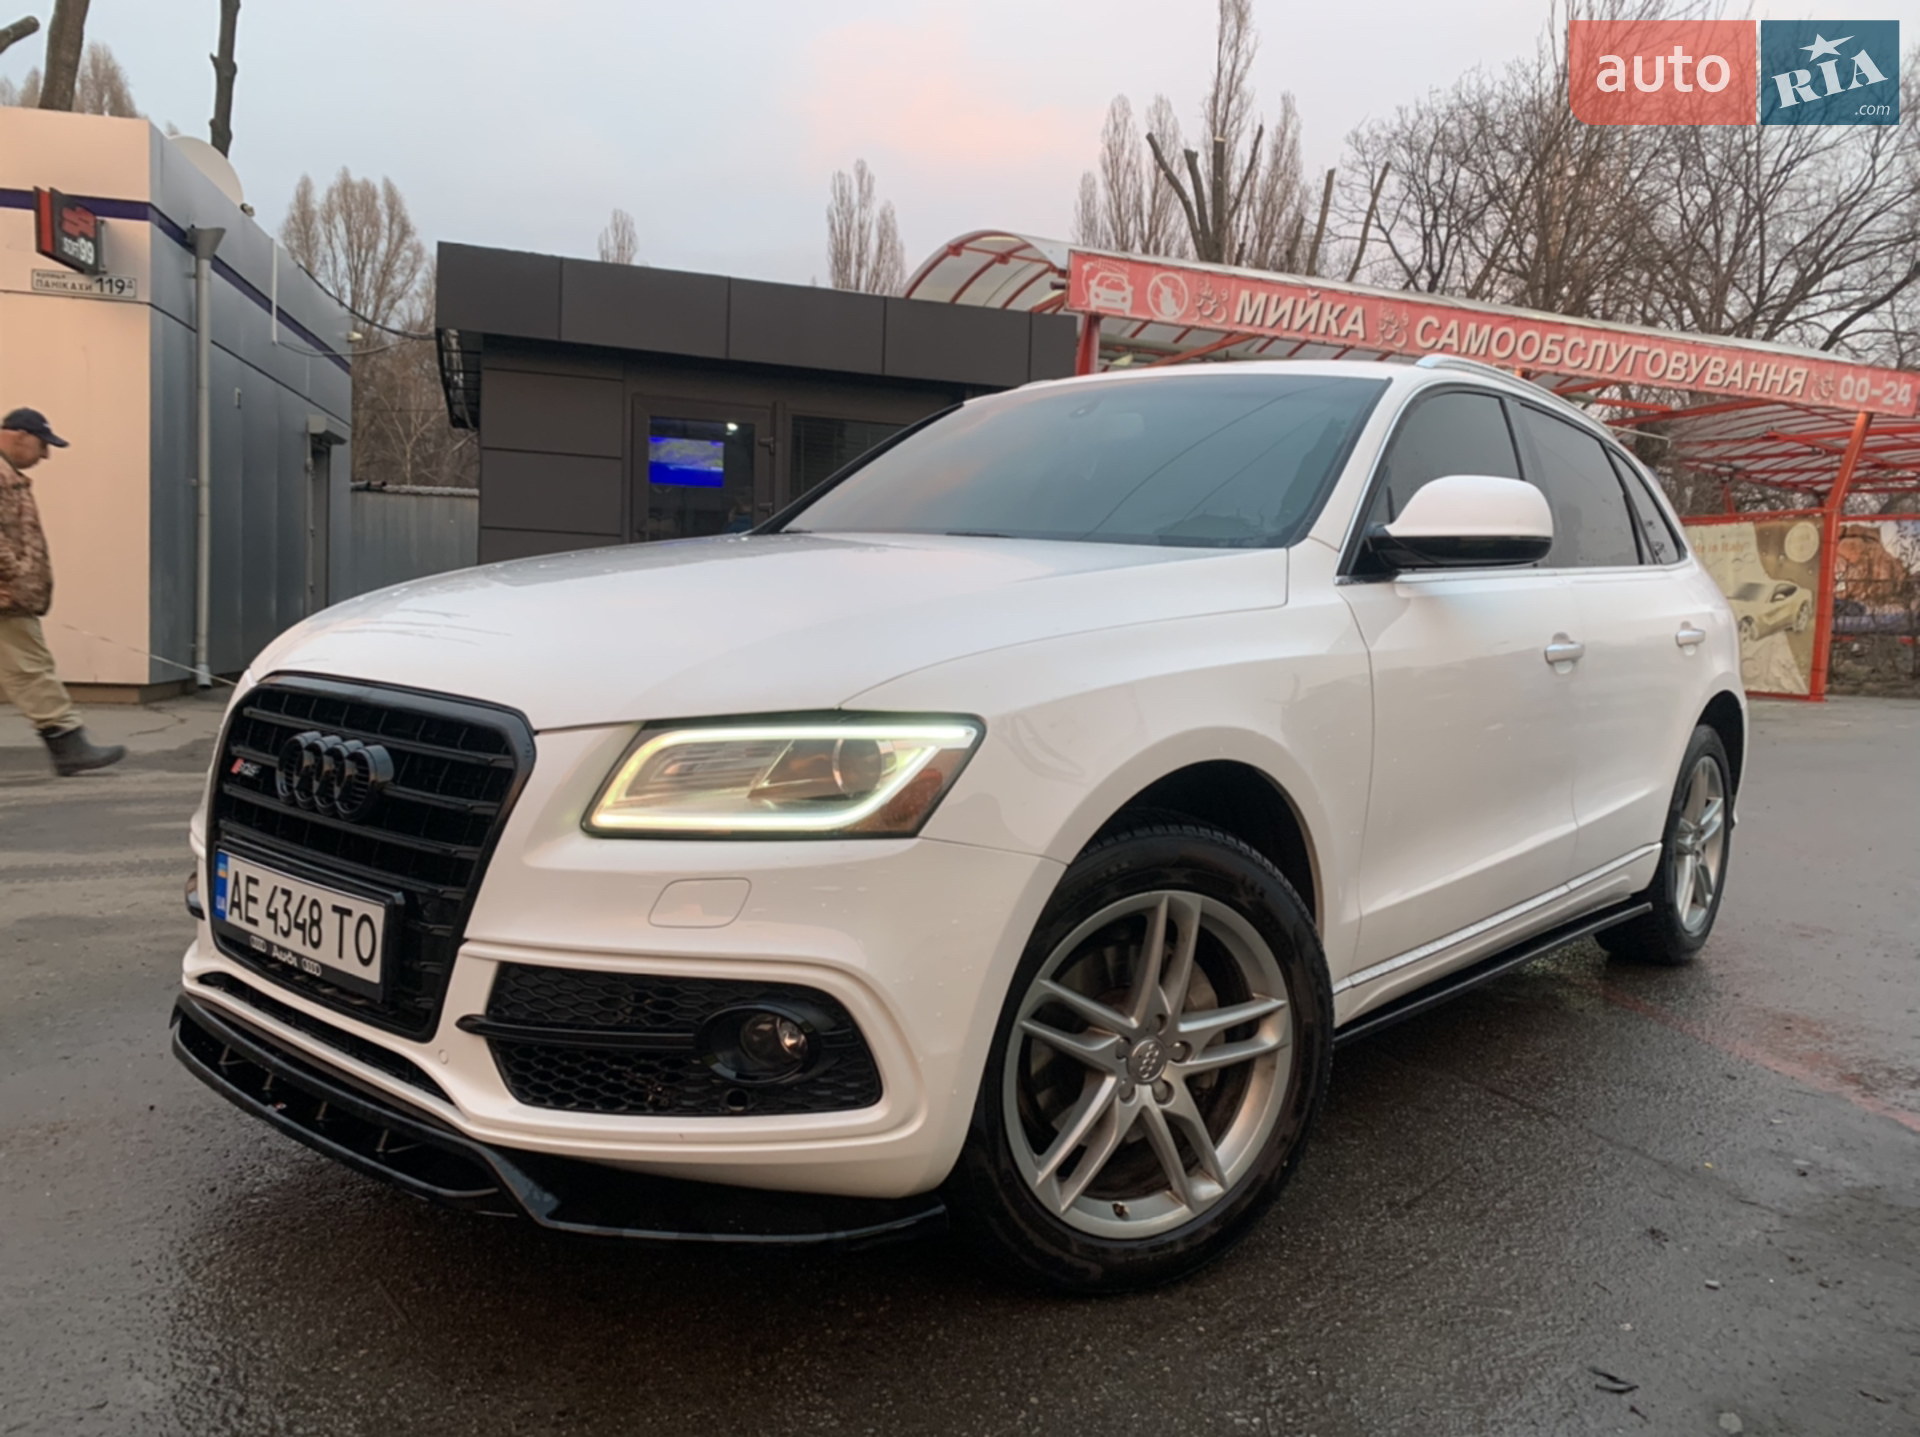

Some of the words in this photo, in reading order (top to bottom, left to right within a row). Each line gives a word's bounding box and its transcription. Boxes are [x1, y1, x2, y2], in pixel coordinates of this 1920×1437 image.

[1234, 289, 1366, 339] МИЙКА
[1415, 314, 1808, 396] САМООБСЛУГОВУВАННЯ
[229, 870, 260, 928] AE
[266, 885, 323, 950] 4348
[331, 903, 377, 968] TO
